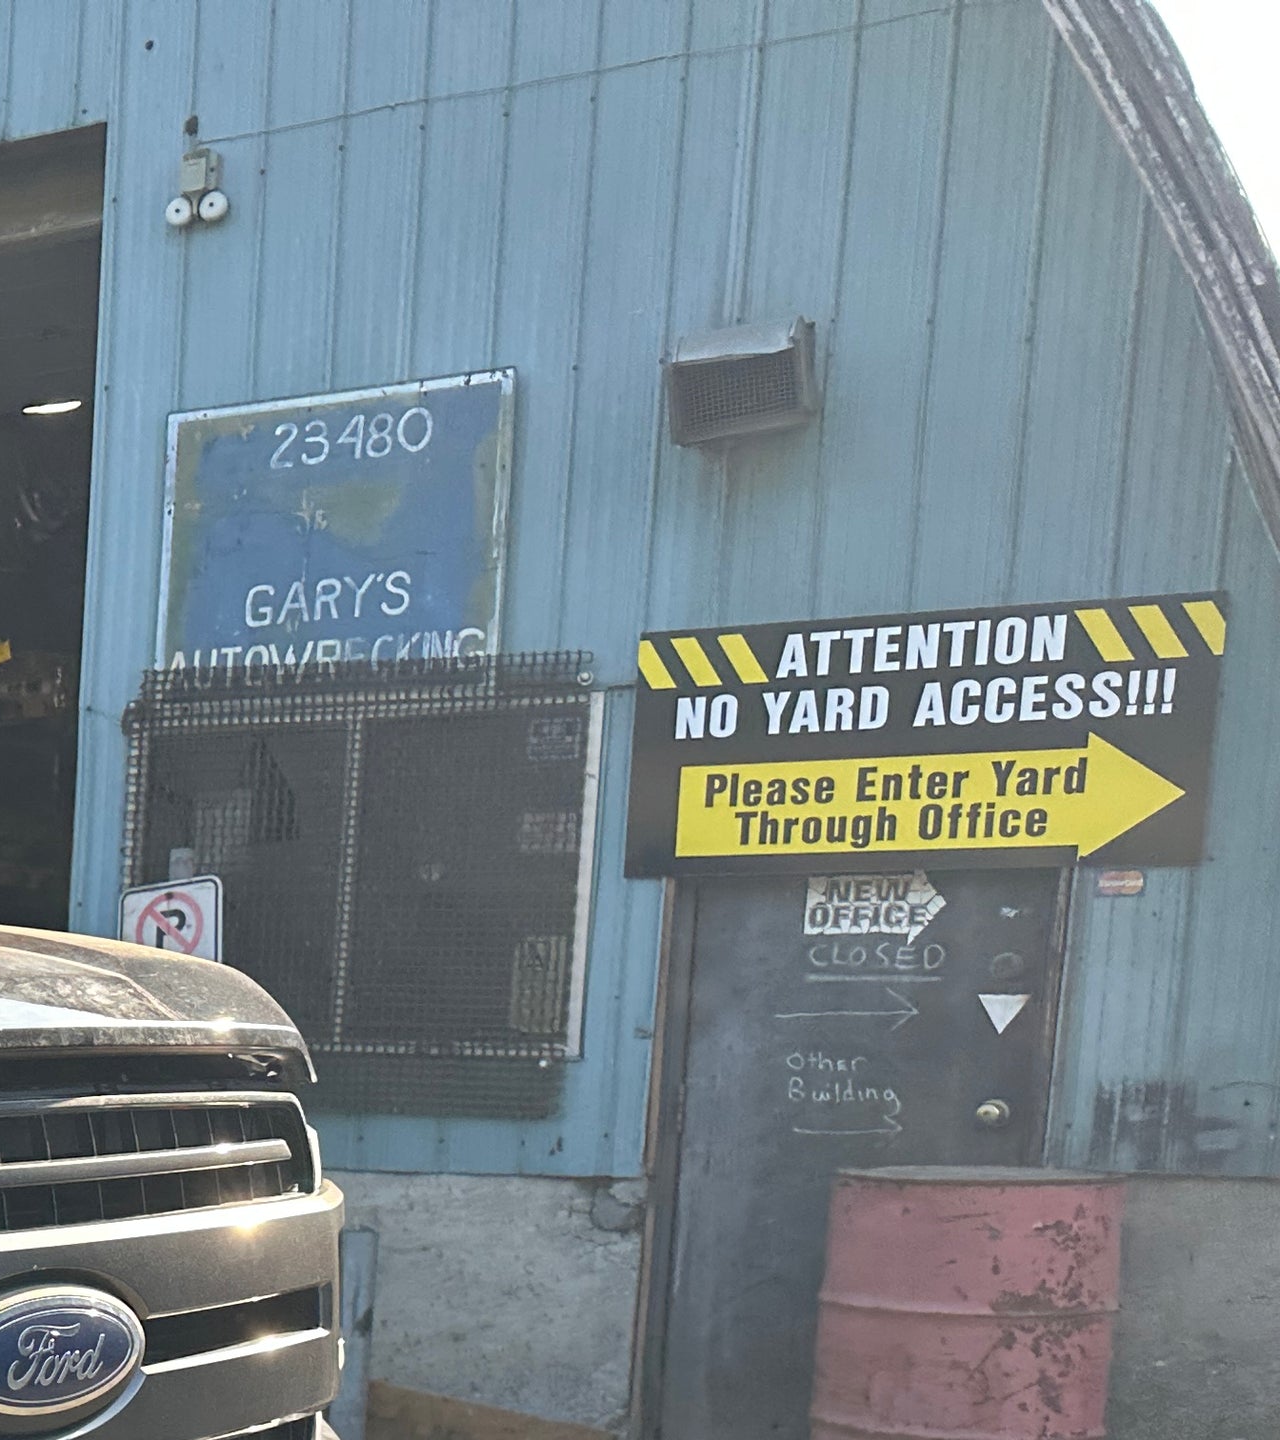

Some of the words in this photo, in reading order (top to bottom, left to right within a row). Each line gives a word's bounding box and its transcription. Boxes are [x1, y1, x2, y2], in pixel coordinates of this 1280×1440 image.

[270, 407, 433, 469] 23480
[245, 571, 411, 627] GARY'S
[776, 615, 1067, 679] ATTENTION
[675, 694, 738, 740] NO
[762, 686, 890, 735] YARD
[913, 668, 1176, 727] ACCESS!!!
[705, 773, 835, 808] Please
[856, 764, 970, 802] Enter
[991, 757, 1088, 796] Yard
[735, 806, 897, 848] Through
[918, 802, 1048, 840] Office
[827, 877, 911, 901] NEW
[809, 942, 945, 970] CLOSED
[788, 1077, 901, 1117] Building
[7, 1322, 106, 1390] Ford
